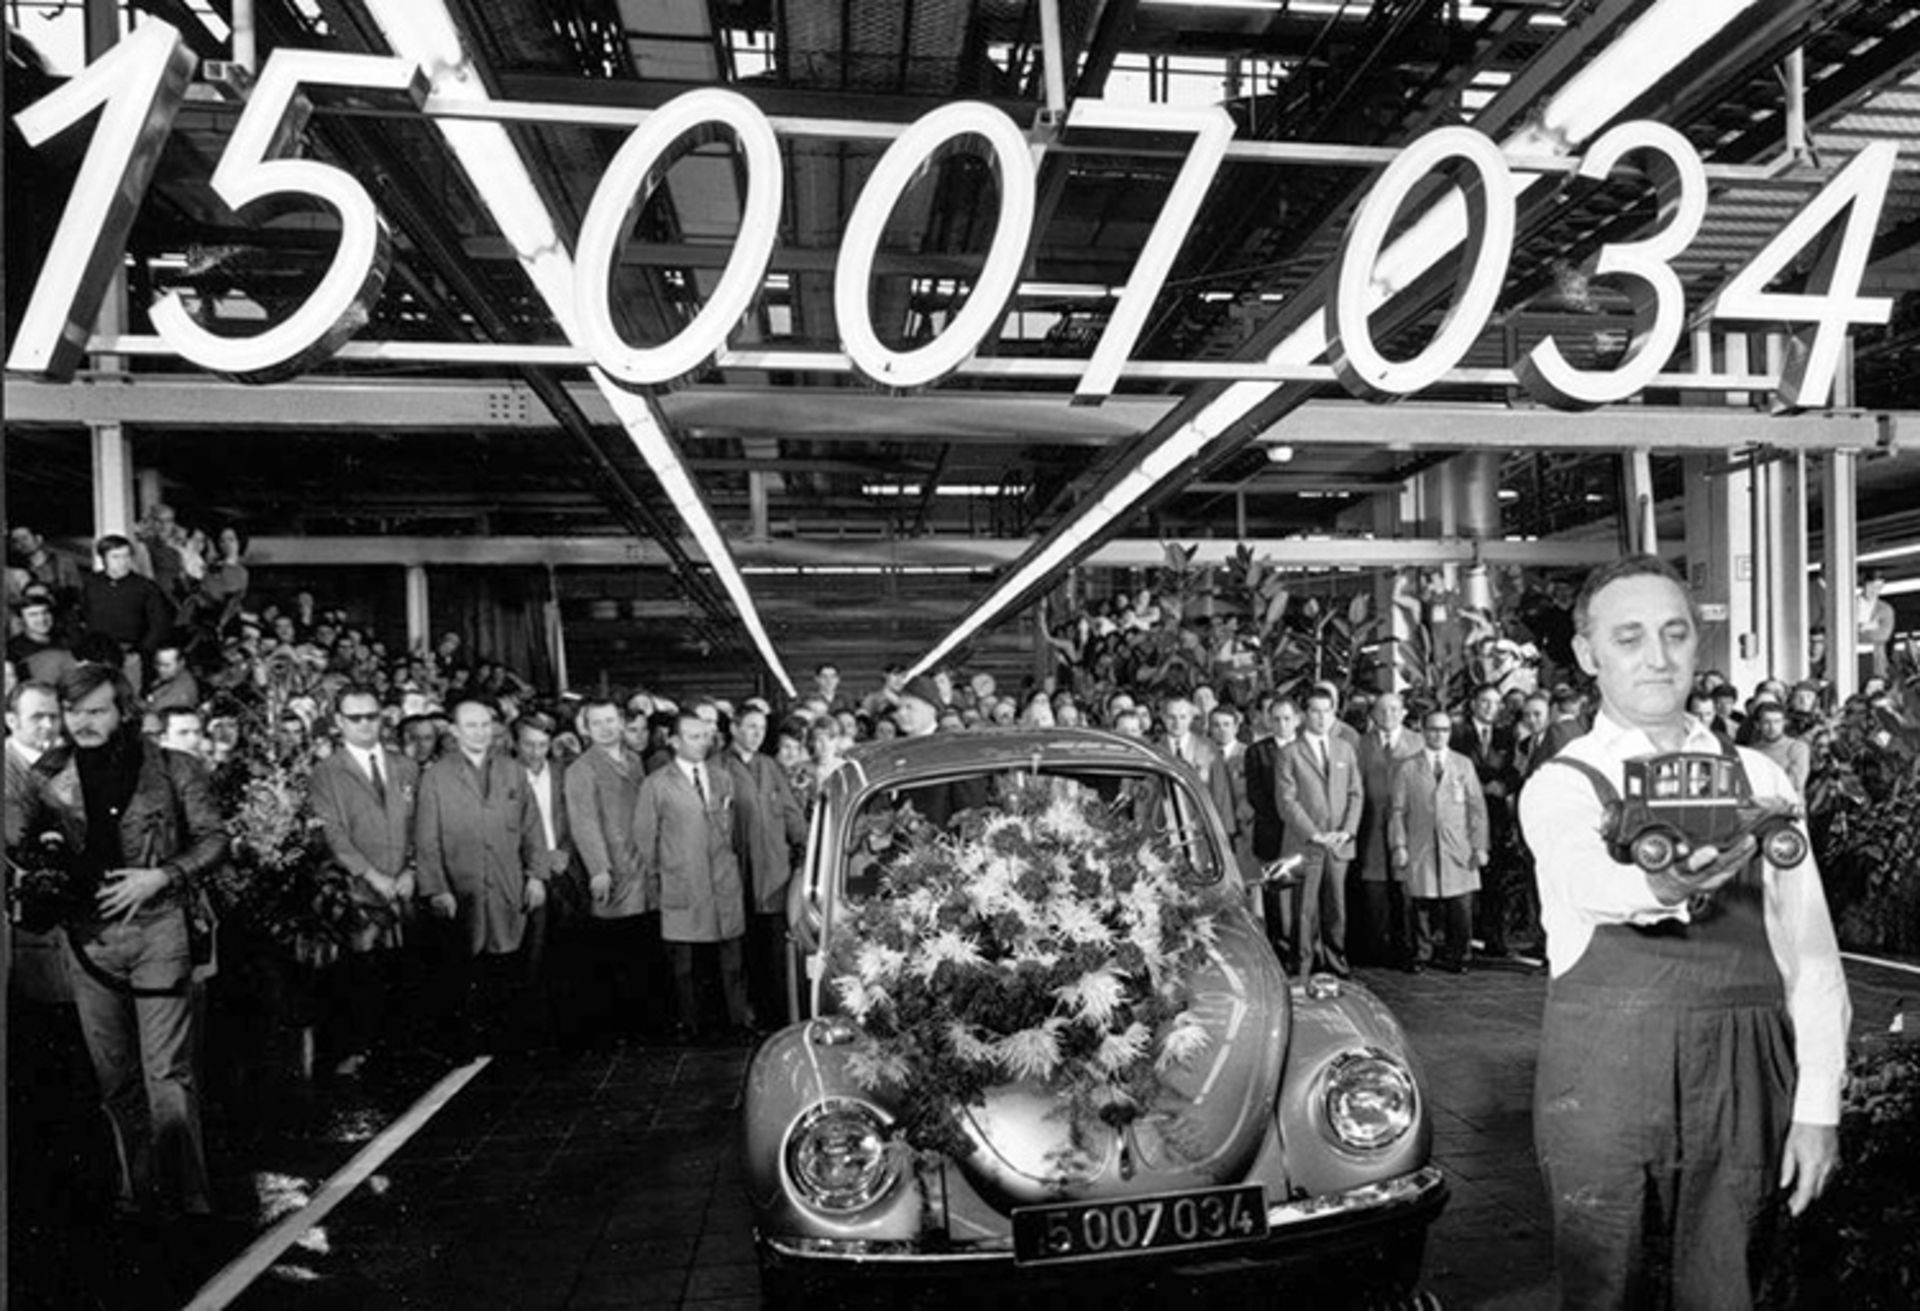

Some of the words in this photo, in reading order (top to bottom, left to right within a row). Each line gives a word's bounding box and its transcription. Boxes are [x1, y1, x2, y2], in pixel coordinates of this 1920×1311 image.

[7, 18, 422, 374] 15
[575, 87, 1237, 404] 007
[1335, 120, 1898, 408] 034
[1082, 1202, 1163, 1249] 007
[1174, 1193, 1253, 1238] 034
